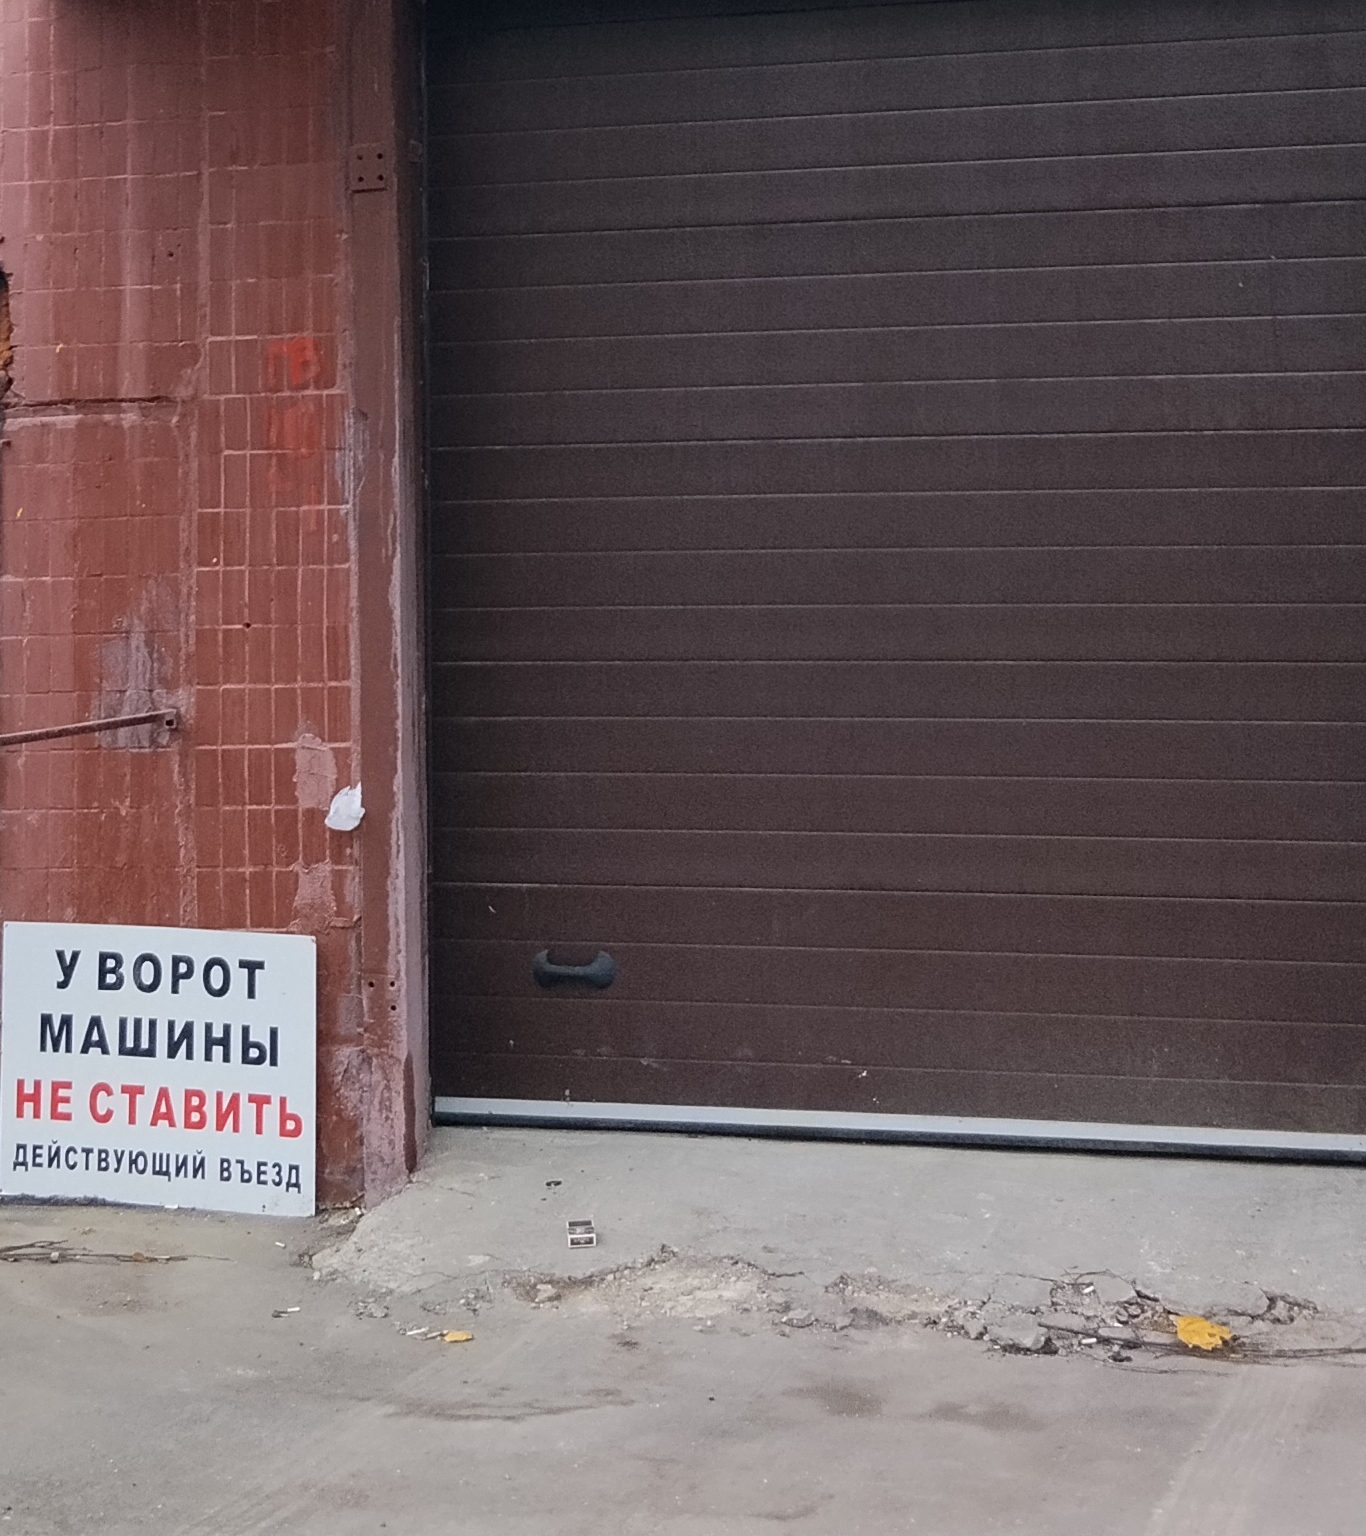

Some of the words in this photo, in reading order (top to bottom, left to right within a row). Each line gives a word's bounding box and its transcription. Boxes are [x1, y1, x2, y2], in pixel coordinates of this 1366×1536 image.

[55, 949, 81, 990] У
[97, 950, 266, 1000] ВОРОТ
[39, 1012, 279, 1067] МАШИНЫ
[15, 1078, 73, 1121] НЕ
[88, 1081, 304, 1138] СТАВИТЬ
[13, 1139, 206, 1182] ДЕЙСТВУЮЩИЙ
[219, 1157, 302, 1194] ВЪЕЗД
